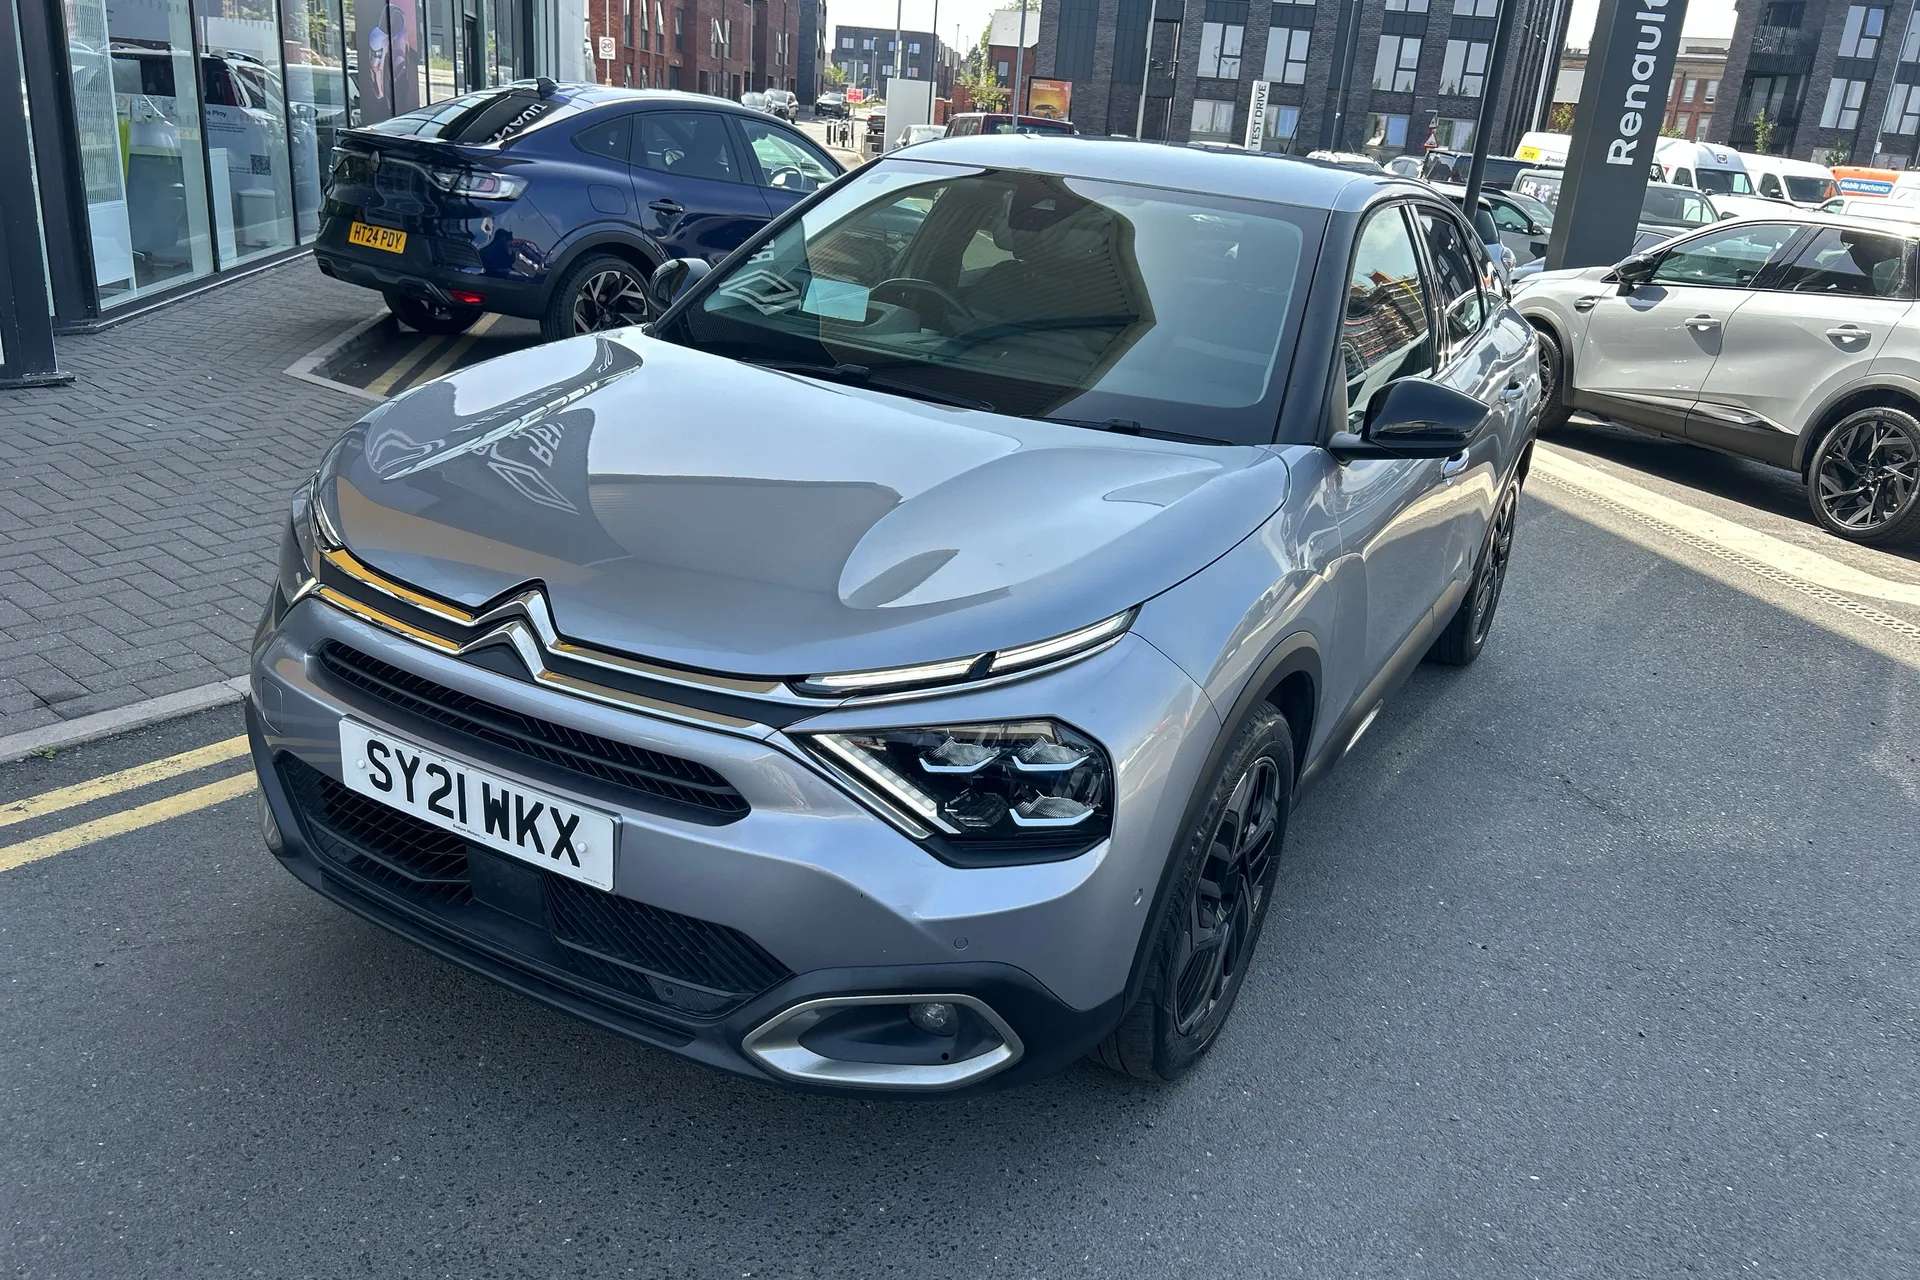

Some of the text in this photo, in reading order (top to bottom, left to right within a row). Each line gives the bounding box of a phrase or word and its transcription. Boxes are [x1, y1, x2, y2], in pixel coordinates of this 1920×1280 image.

[1251, 84, 1267, 146] TEST DRIVE
[354, 224, 402, 249] HT24 PDY
[367, 739, 581, 868] SY21 WKX
